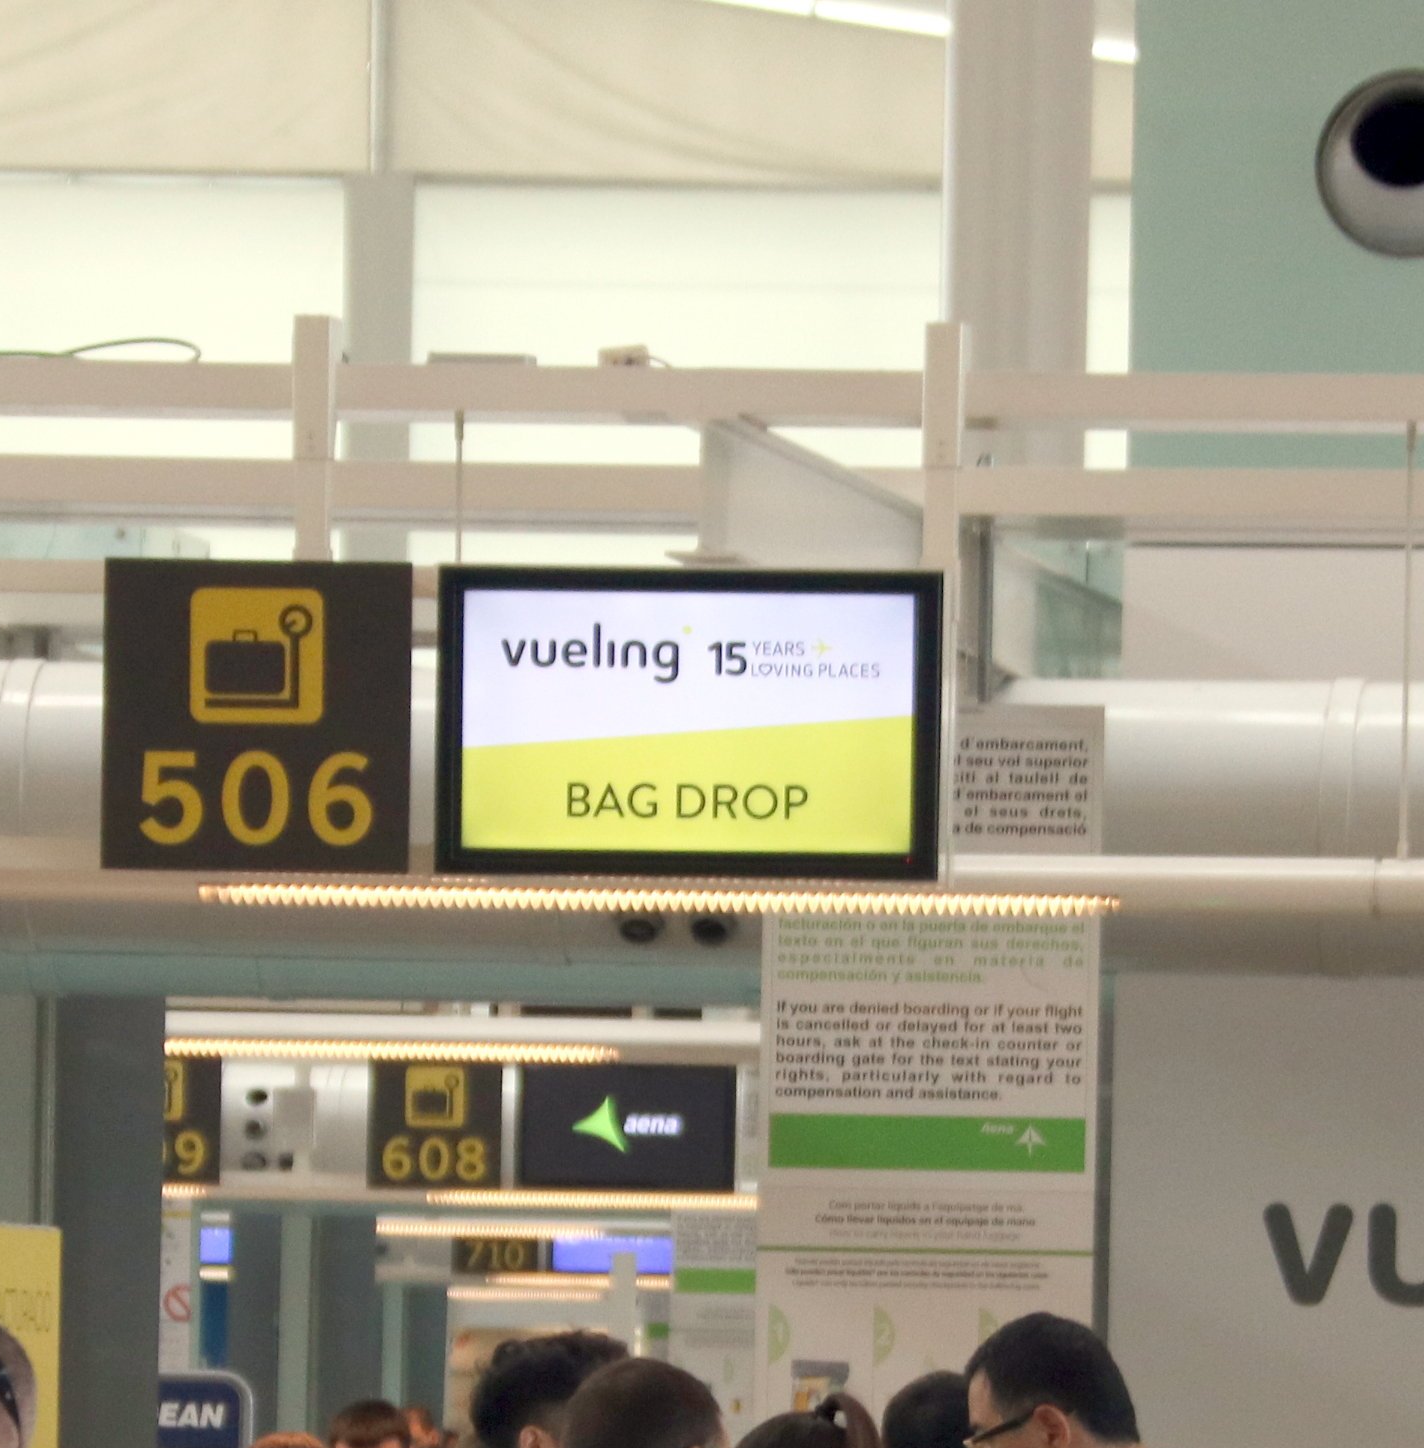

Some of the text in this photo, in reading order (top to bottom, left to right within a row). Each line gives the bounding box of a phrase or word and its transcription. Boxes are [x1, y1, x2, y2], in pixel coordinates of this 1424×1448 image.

[501, 622, 679, 684] vueling
[707, 640, 805, 676] 15 YEARS
[750, 662, 880, 679] LOVING PLACES
[139, 749, 373, 846] 506
[566, 783, 810, 820] BAG DROP
[777, 1001, 1083, 1020] If you are denied boarding or if your flight
[777, 1019, 1082, 1035] is cancelled or delayed for at least two
[776, 1035, 1081, 1051] hours, ask at the check-in counter or
[776, 1052, 1081, 1070] boarding gate for the text stating your
[775, 1069, 1081, 1086] rights, particularly with regard to
[775, 1087, 1002, 1101] compensation and assistance.
[623, 1112, 682, 1136] aena
[382, 1135, 486, 1180] 608
[466, 1239, 524, 1270] 710
